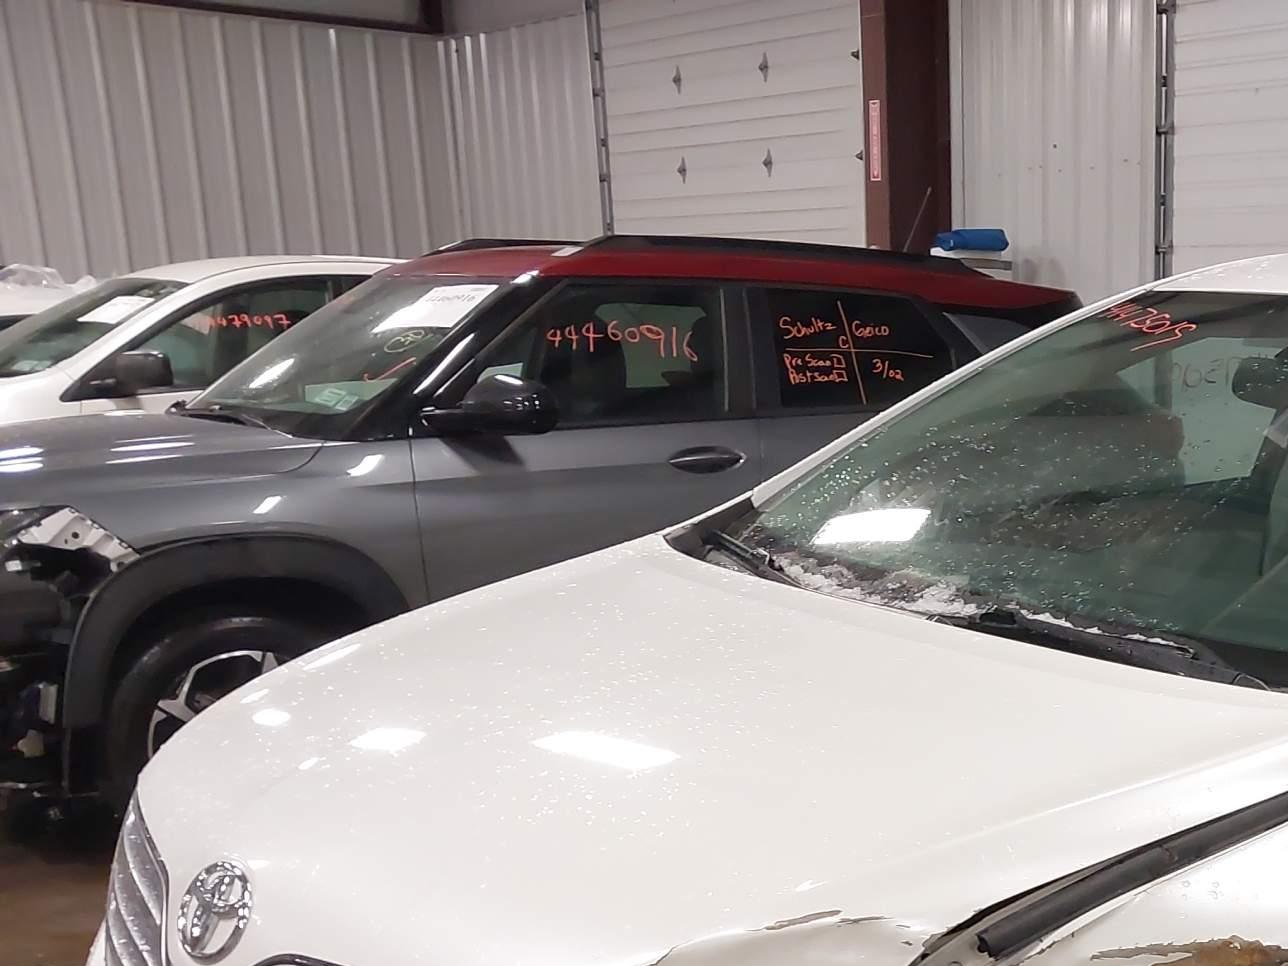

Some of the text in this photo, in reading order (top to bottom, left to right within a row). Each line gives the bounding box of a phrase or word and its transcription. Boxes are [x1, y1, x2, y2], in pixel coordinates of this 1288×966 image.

[780, 316, 836, 339] Schultz
[547, 320, 698, 361] 44460916
[872, 358, 905, 381] 3/02
